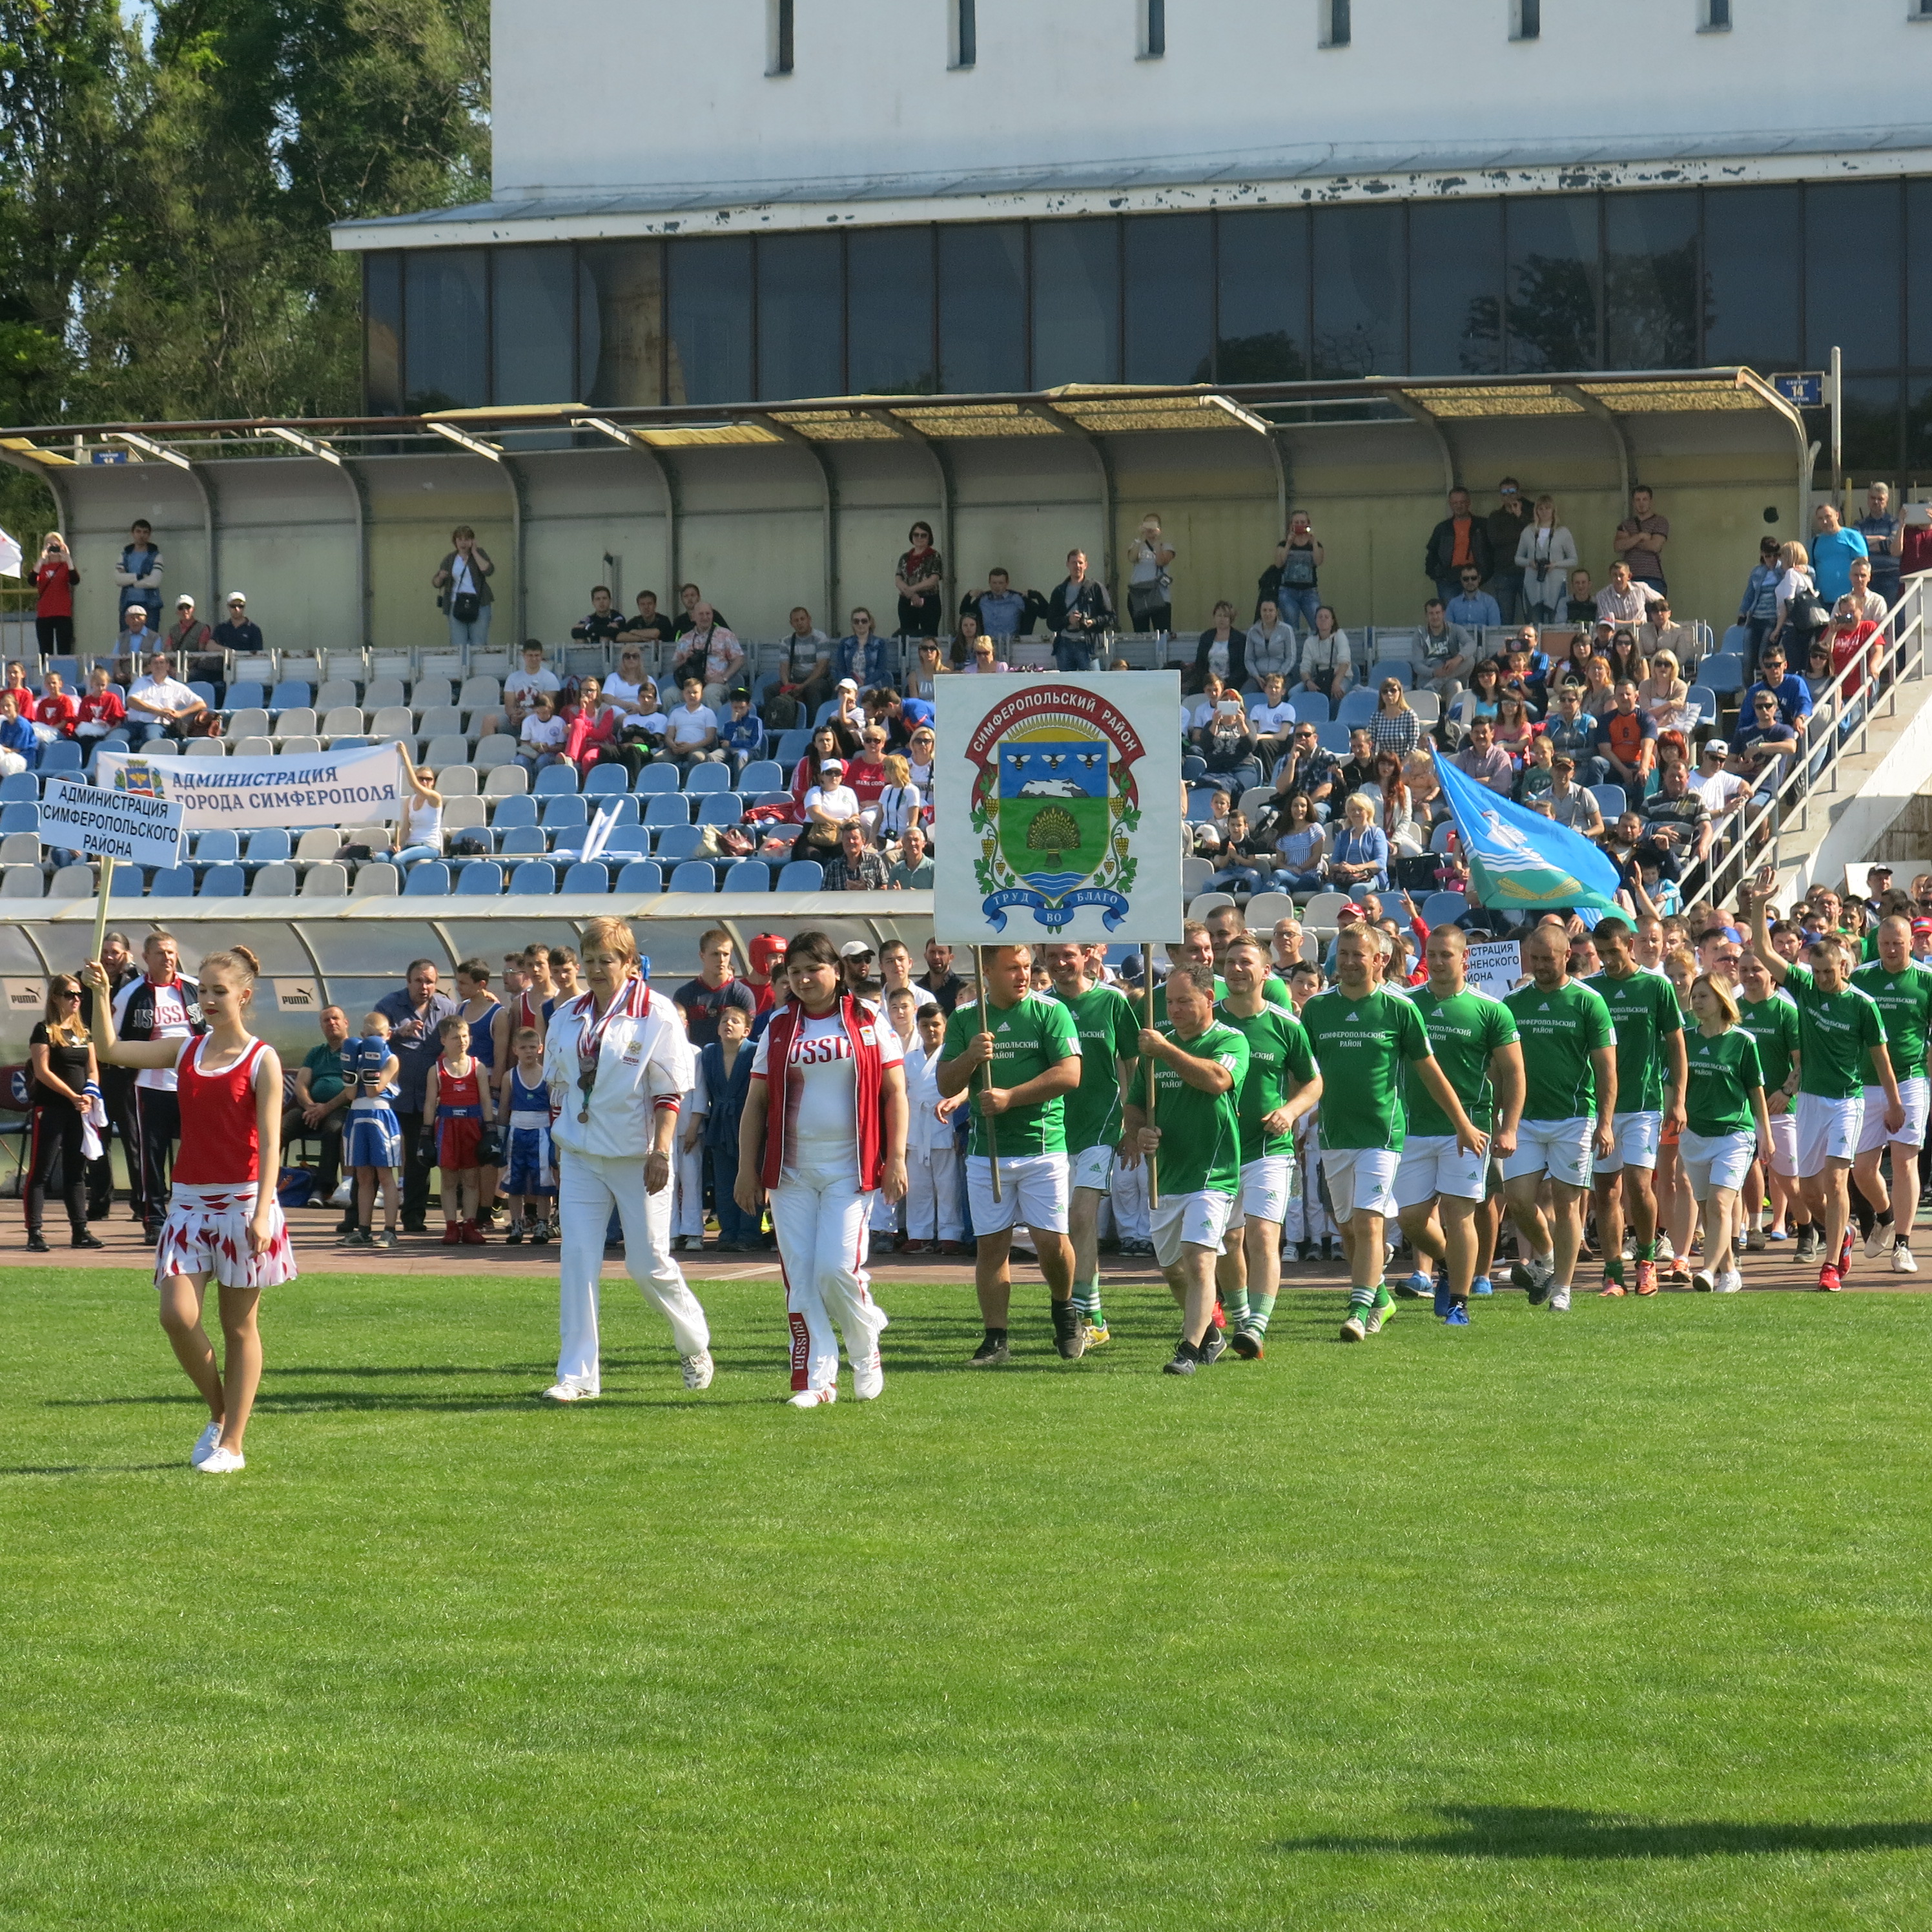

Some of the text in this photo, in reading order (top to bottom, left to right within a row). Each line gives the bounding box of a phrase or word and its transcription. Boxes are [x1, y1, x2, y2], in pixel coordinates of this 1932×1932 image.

[1791, 385, 1804, 396] 14
[973, 692, 1137, 752] СИМФЕРОПОЛЬСКИЙ РАЙОН
[172, 766, 338, 790] АДМИНИСТРАЦИЯ
[59, 785, 169, 819] АДМИНИСТРАЦИЯ
[249, 784, 396, 808] СИМФЕРОПОЛЯ
[43, 805, 178, 843] СИМФЕРОПОЛЬСКОГО
[83, 834, 132, 858] РАЙОНА
[993, 892, 1029, 905] ТРУД
[1077, 892, 1118, 904] БЛАГО
[1046, 913, 1062, 923] ВО
[10, 994, 37, 1003] PUMA
[282, 996, 309, 1005] PUMA
[792, 1321, 807, 1370] RUSSIA
